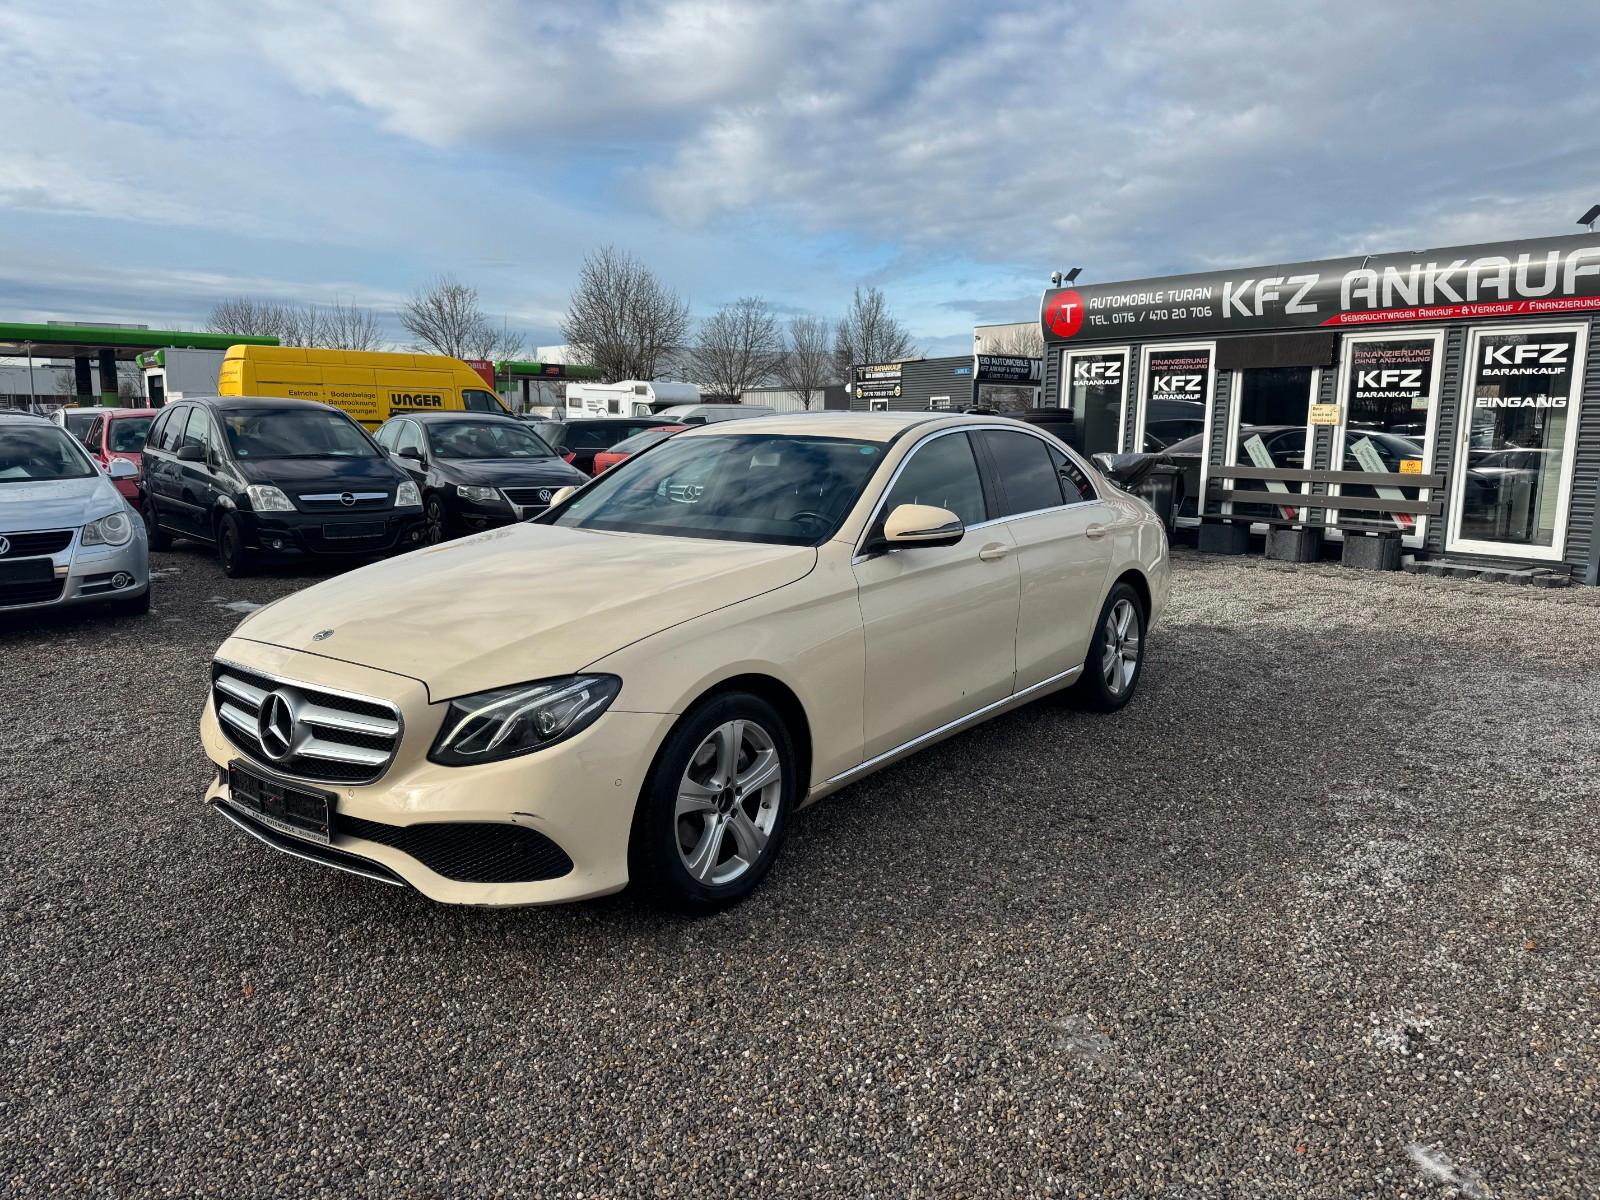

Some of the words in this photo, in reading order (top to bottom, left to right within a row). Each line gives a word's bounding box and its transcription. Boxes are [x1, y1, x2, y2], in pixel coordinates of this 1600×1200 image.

[1222, 273, 1320, 318] KFZ
[1340, 246, 1600, 311] ANKAUF
[1089, 291, 1164, 309] AUTOMOBILE
[1168, 286, 1212, 303] TURAN
[1089, 314, 1110, 325] TEL.
[1112, 312, 1135, 324] 0176
[1149, 309, 1168, 320] 470
[1171, 308, 1187, 319] 20
[1190, 306, 1213, 318] 706
[1354, 348, 1432, 358] FINANZIERUNG
[1378, 356, 1431, 364] ANZAHLUNG
[1484, 343, 1569, 365] KFZ
[1074, 361, 1122, 378] KFZ
[1482, 367, 1566, 376] BARANKAUF
[1153, 375, 1203, 392] KFZ
[1357, 369, 1423, 388] KFZ
[391, 393, 442, 407] UNGER
[1356, 390, 1421, 398] BARANKAUF
[1475, 396, 1567, 408] EINGANG
